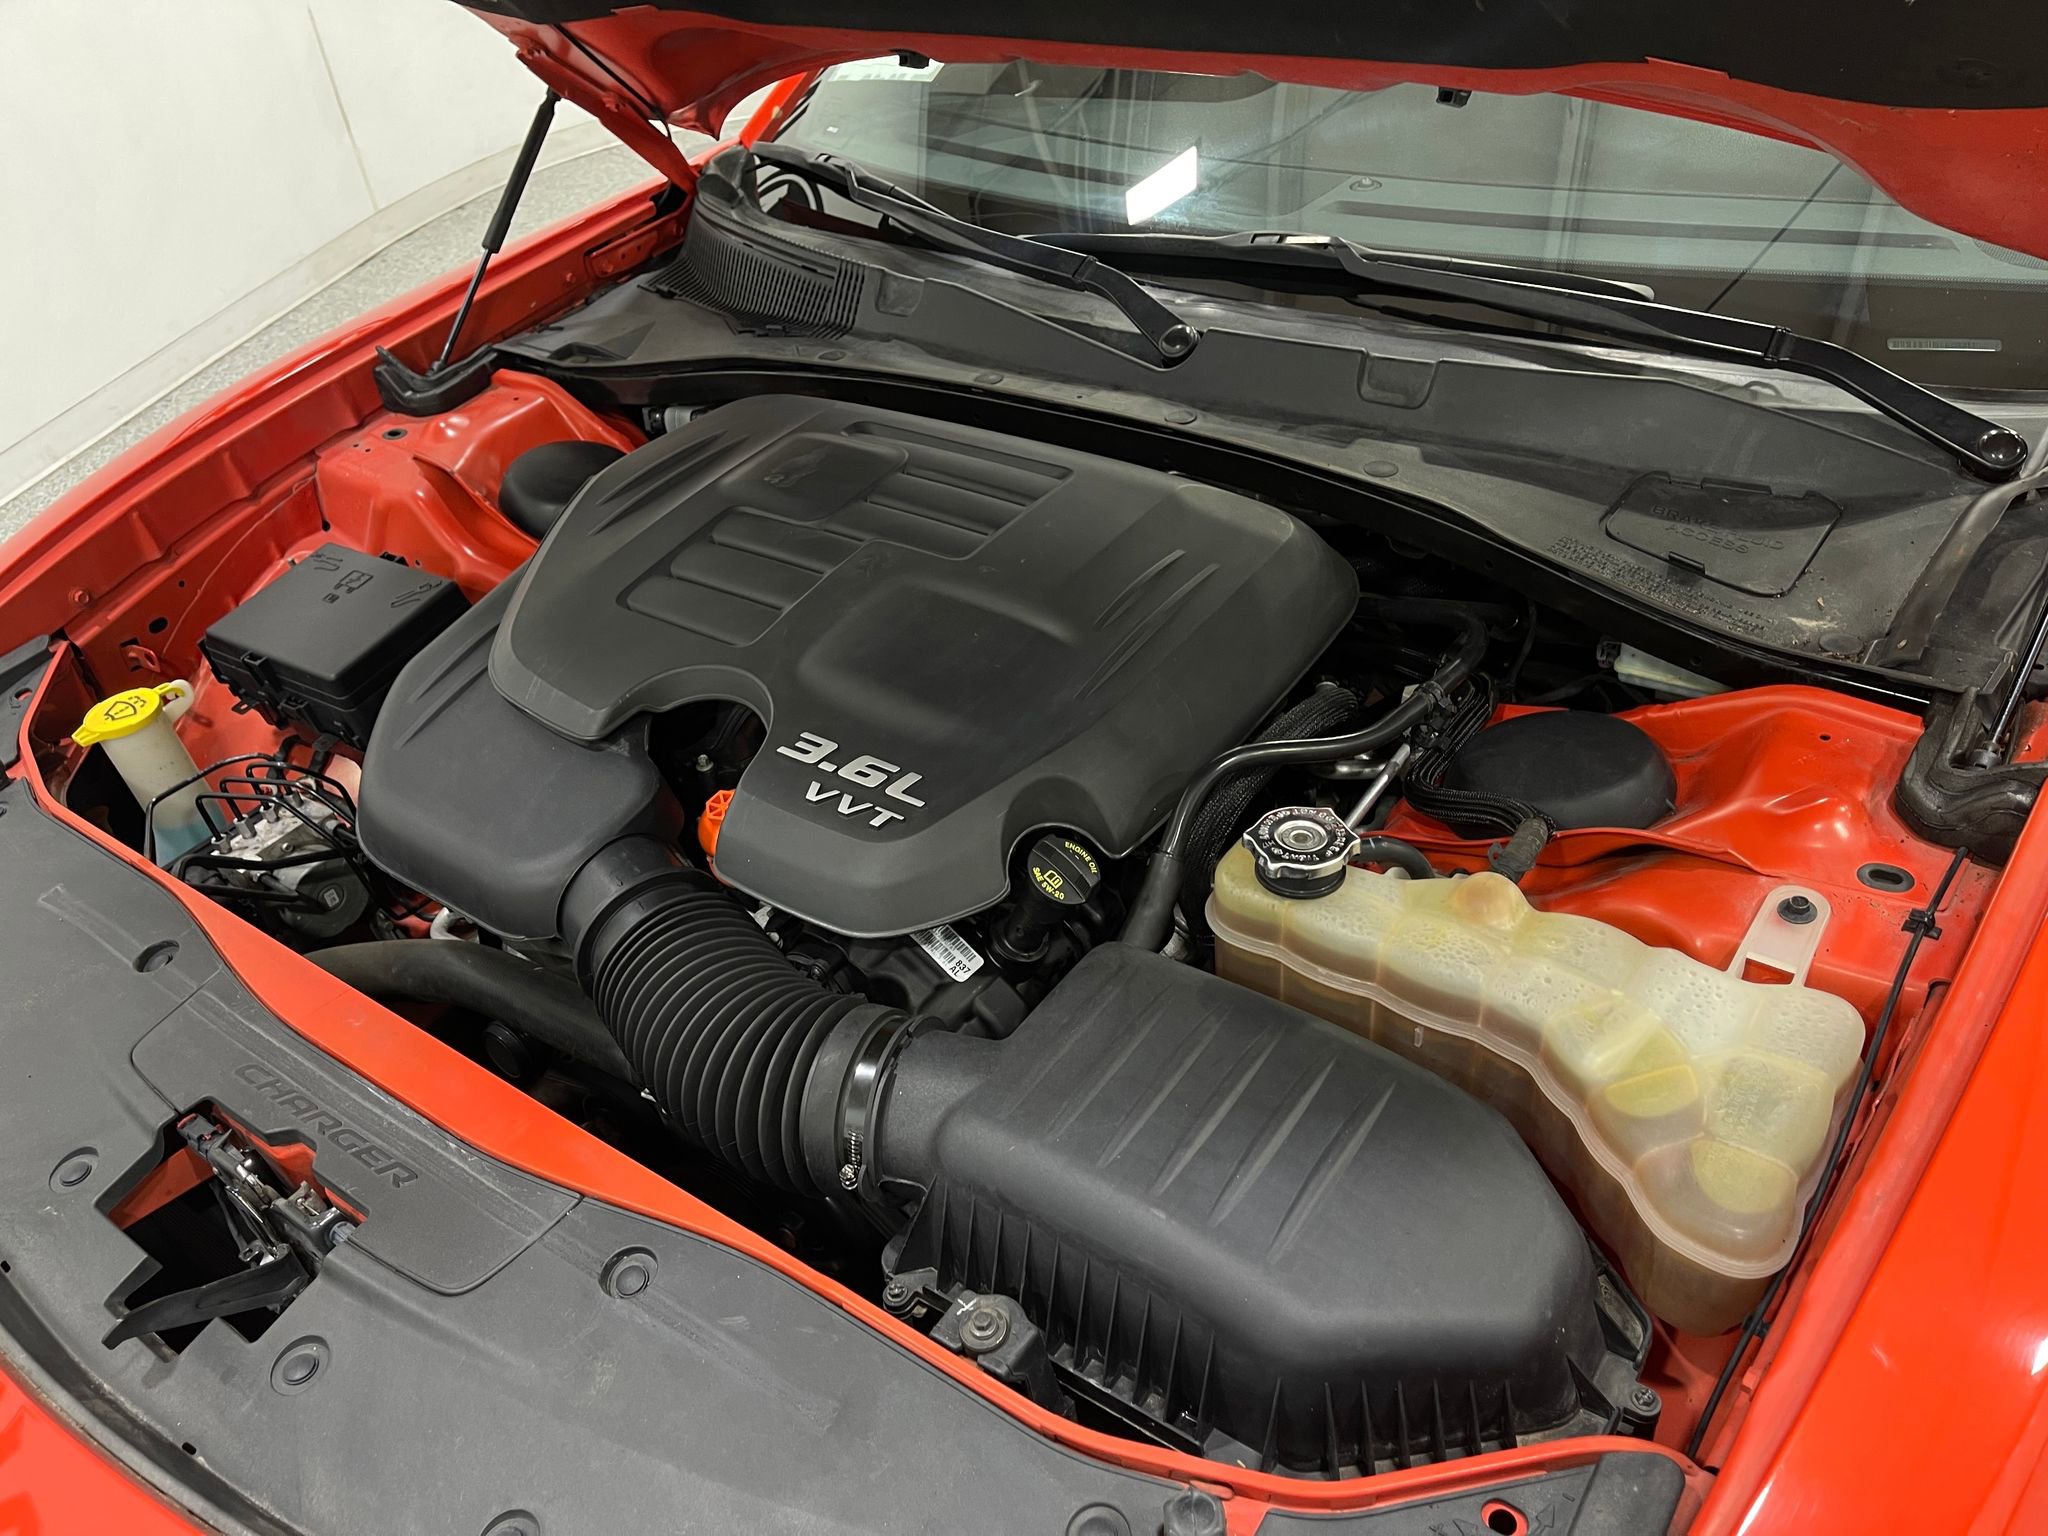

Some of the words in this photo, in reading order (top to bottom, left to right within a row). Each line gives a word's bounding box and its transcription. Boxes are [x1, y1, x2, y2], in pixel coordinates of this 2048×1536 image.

[1653, 505, 1720, 534] BRAKE
[1664, 524, 1749, 554] ACCESS
[776, 731, 926, 808] 3.6L
[805, 780, 905, 828] VVT
[1064, 841, 1092, 862] ENGINE
[1088, 861, 1098, 874] OIL
[1032, 866, 1045, 883] SAE
[1041, 881, 1065, 900] 5W-20
[948, 966, 960, 977] AL
[955, 959, 972, 974] 837
[233, 1063, 419, 1189] CHARGER
